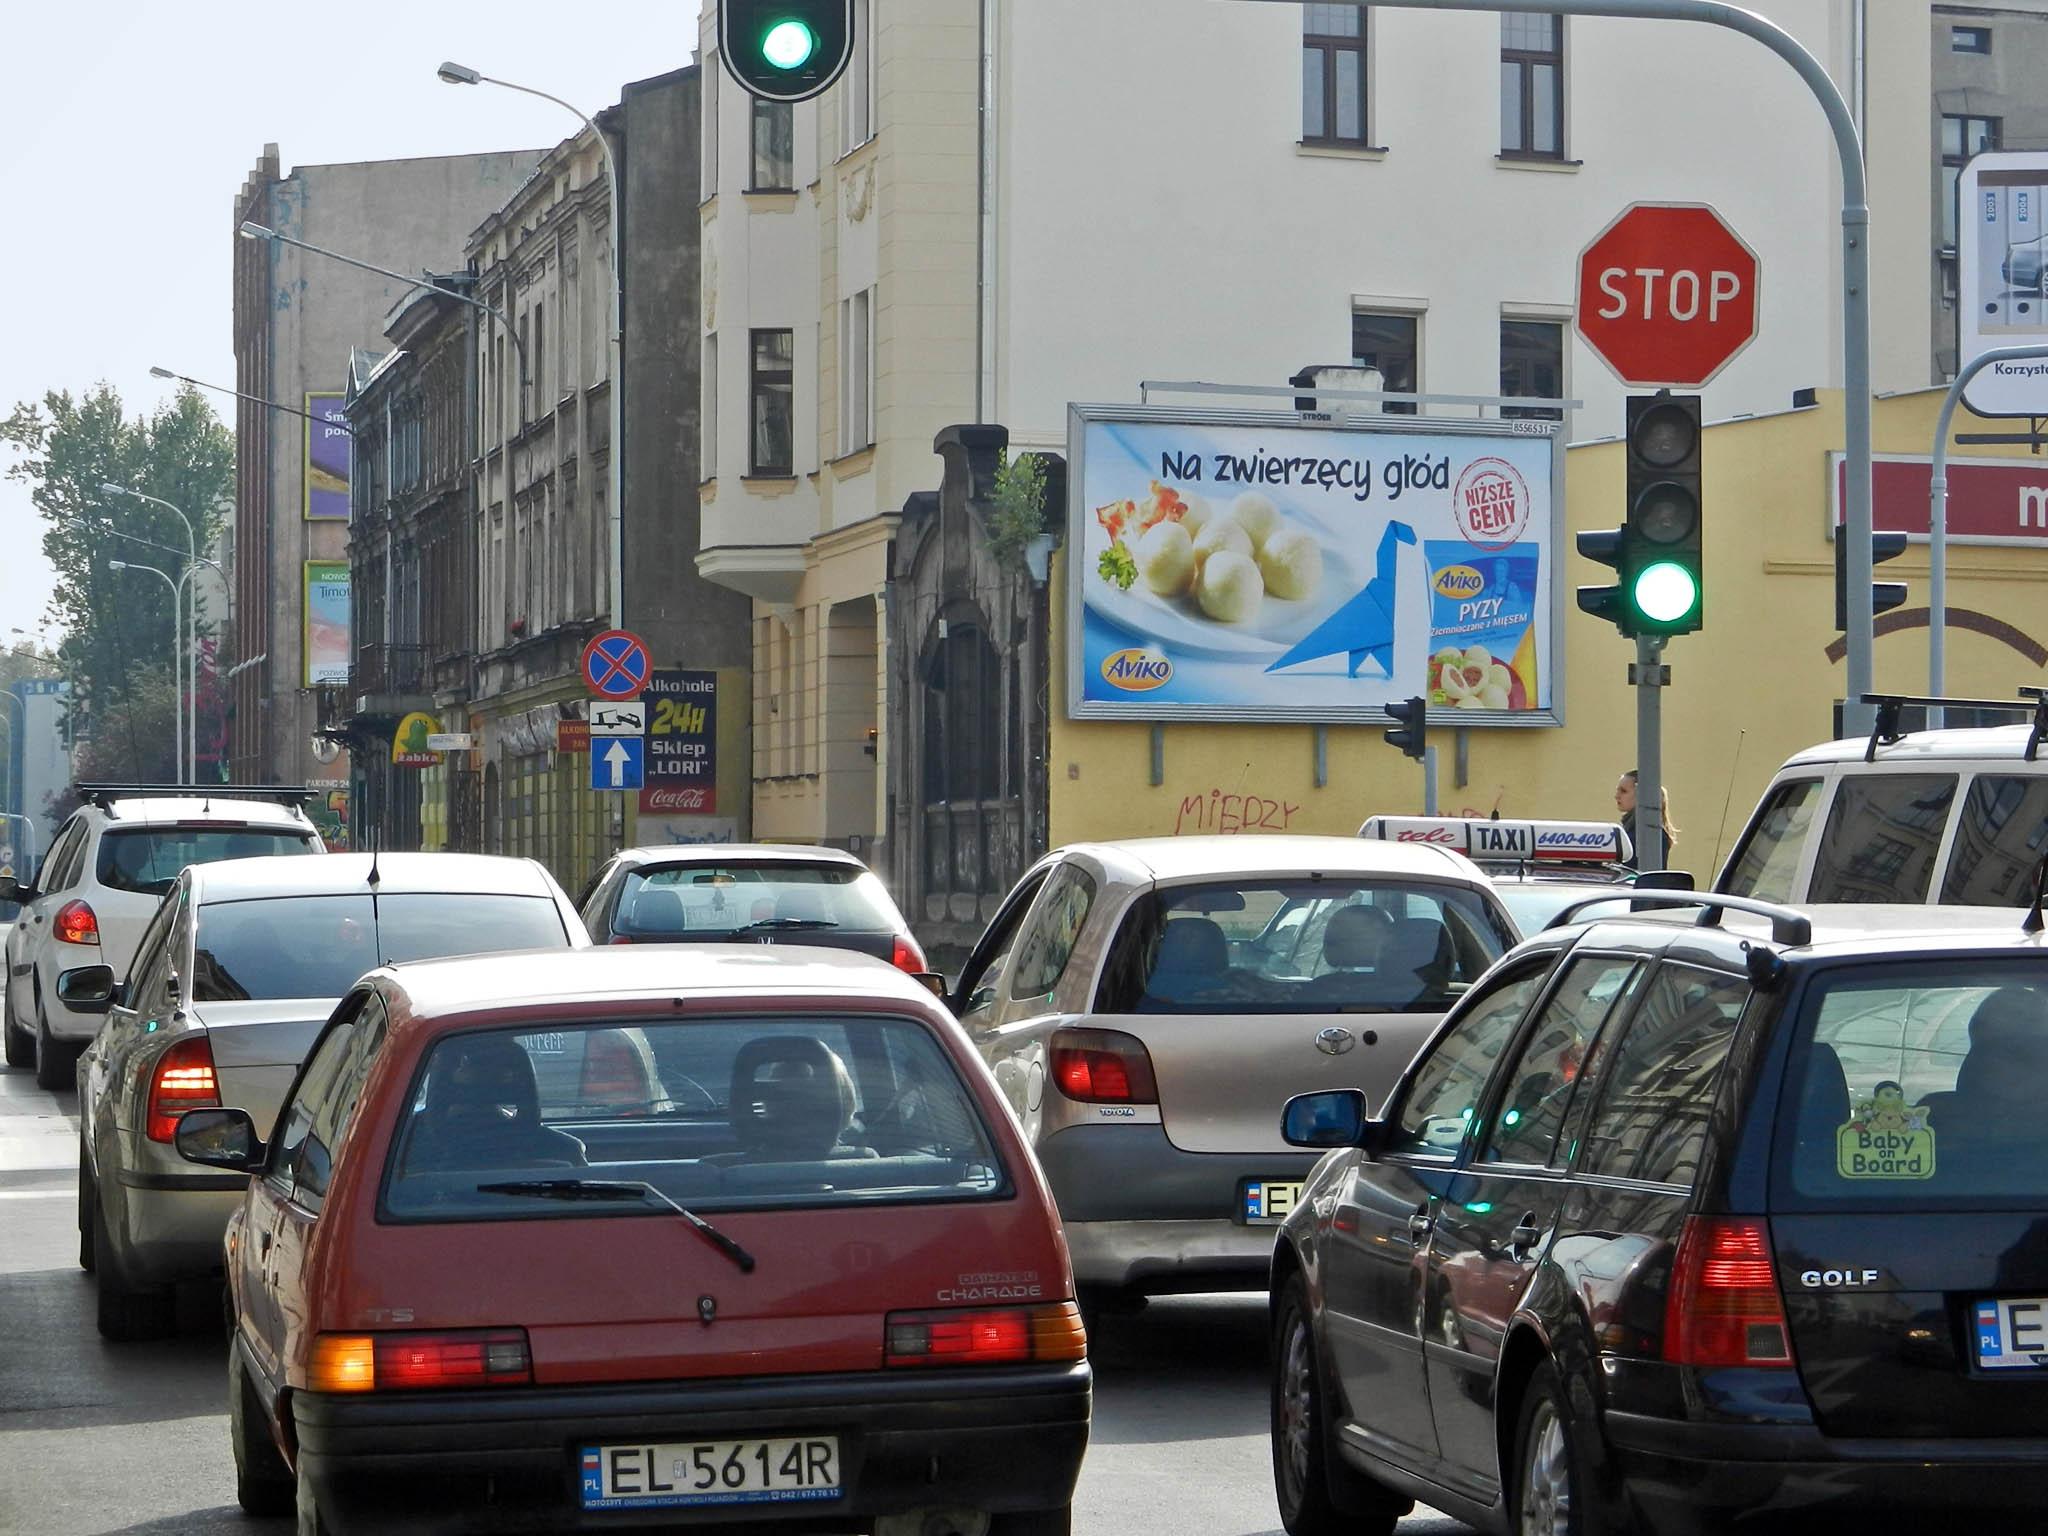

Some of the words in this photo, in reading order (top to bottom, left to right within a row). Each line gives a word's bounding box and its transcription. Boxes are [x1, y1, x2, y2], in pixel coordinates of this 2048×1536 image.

[1598, 267, 1741, 322] STOP
[1513, 423, 1549, 434] 8556531
[1162, 451, 1201, 481] Na
[1214, 447, 1371, 501] zwierzęcy
[1383, 453, 1449, 500] głód
[1465, 480, 1515, 507] NIŻSZE
[1469, 500, 1516, 531] CENY
[1436, 570, 1482, 591] Aviko
[1459, 597, 1504, 622] PYZY
[1106, 655, 1170, 681] Aviko
[643, 680, 715, 693] Alkohole
[650, 698, 706, 735] 24H
[651, 740, 706, 758] Sklep
[1477, 827, 1525, 851] TAXI
[1537, 832, 1605, 845] 6400-400
[1100, 1107, 1135, 1116] TOYOTA
[1858, 1131, 1915, 1154] Baby
[1879, 1149, 1895, 1158] on
[1853, 1155, 1921, 1173] Board
[1248, 1206, 1260, 1215] PL
[1800, 1270, 1877, 1287] GOLF
[937, 1285, 1042, 1301] CHARADE
[367, 1308, 415, 1322] TS
[1981, 1336, 1999, 1349] PL
[611, 1449, 673, 1493] EL
[693, 1441, 832, 1489] 5614R
[584, 1479, 599, 1491] PL
